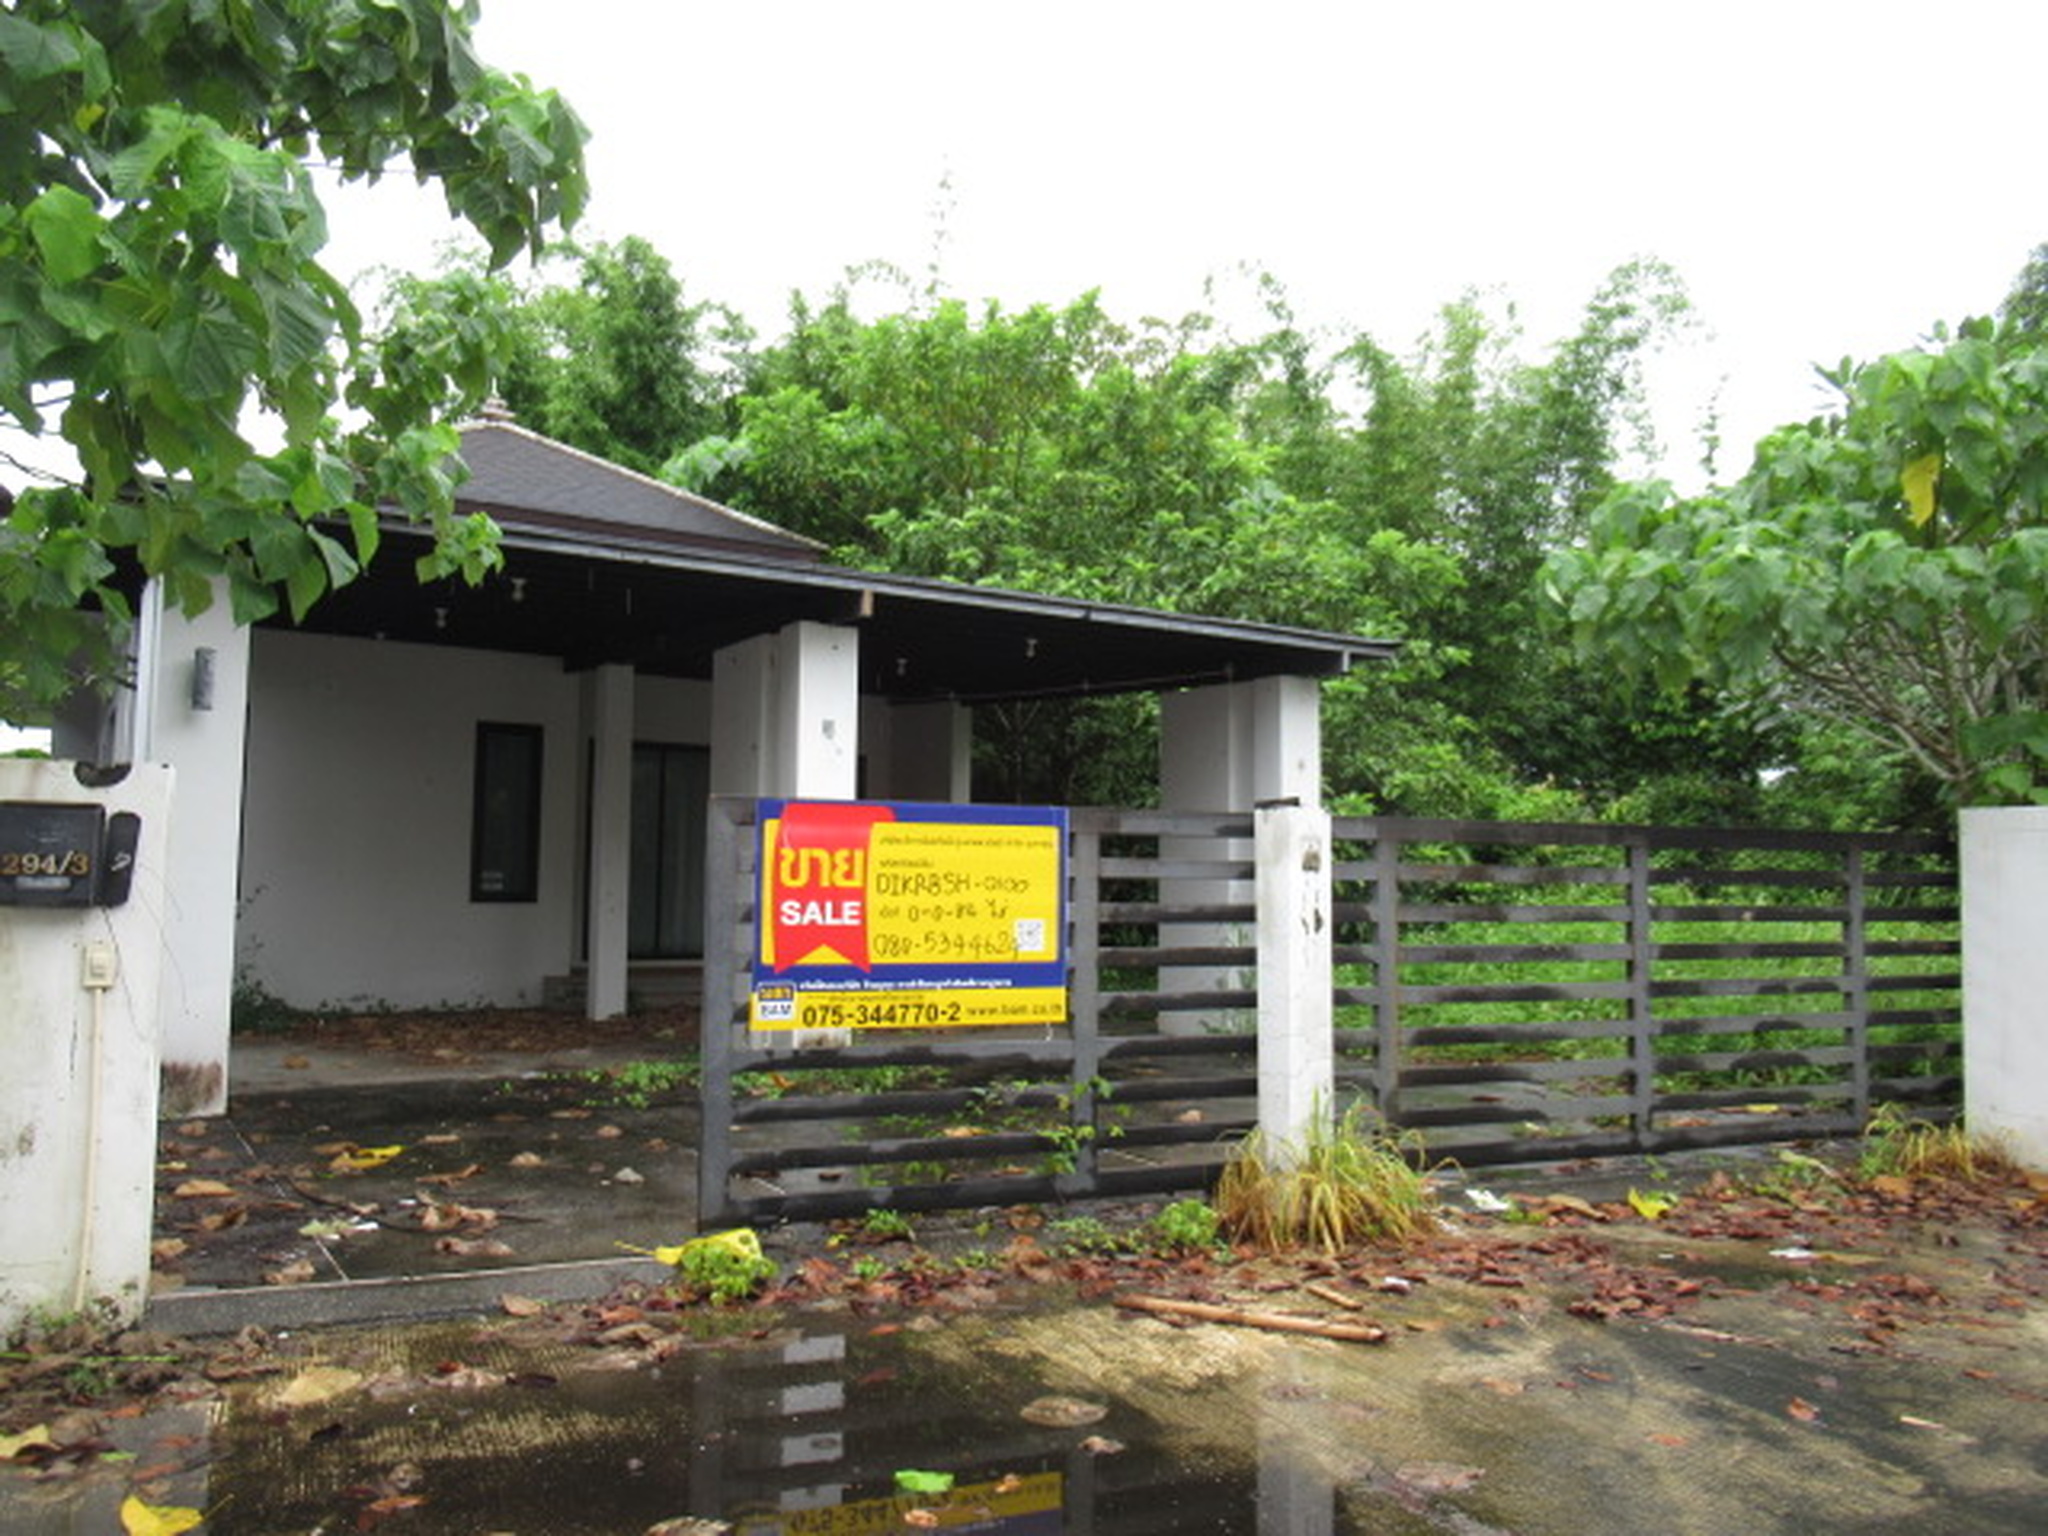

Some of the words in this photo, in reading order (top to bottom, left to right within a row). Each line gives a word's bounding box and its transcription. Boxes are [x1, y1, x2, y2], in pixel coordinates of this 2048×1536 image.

[2, 850, 89, 875] 294/3
[780, 847, 864, 887] ขาย
[780, 899, 862, 926] SALE
[802, 1001, 962, 1027] 075-344770-2
